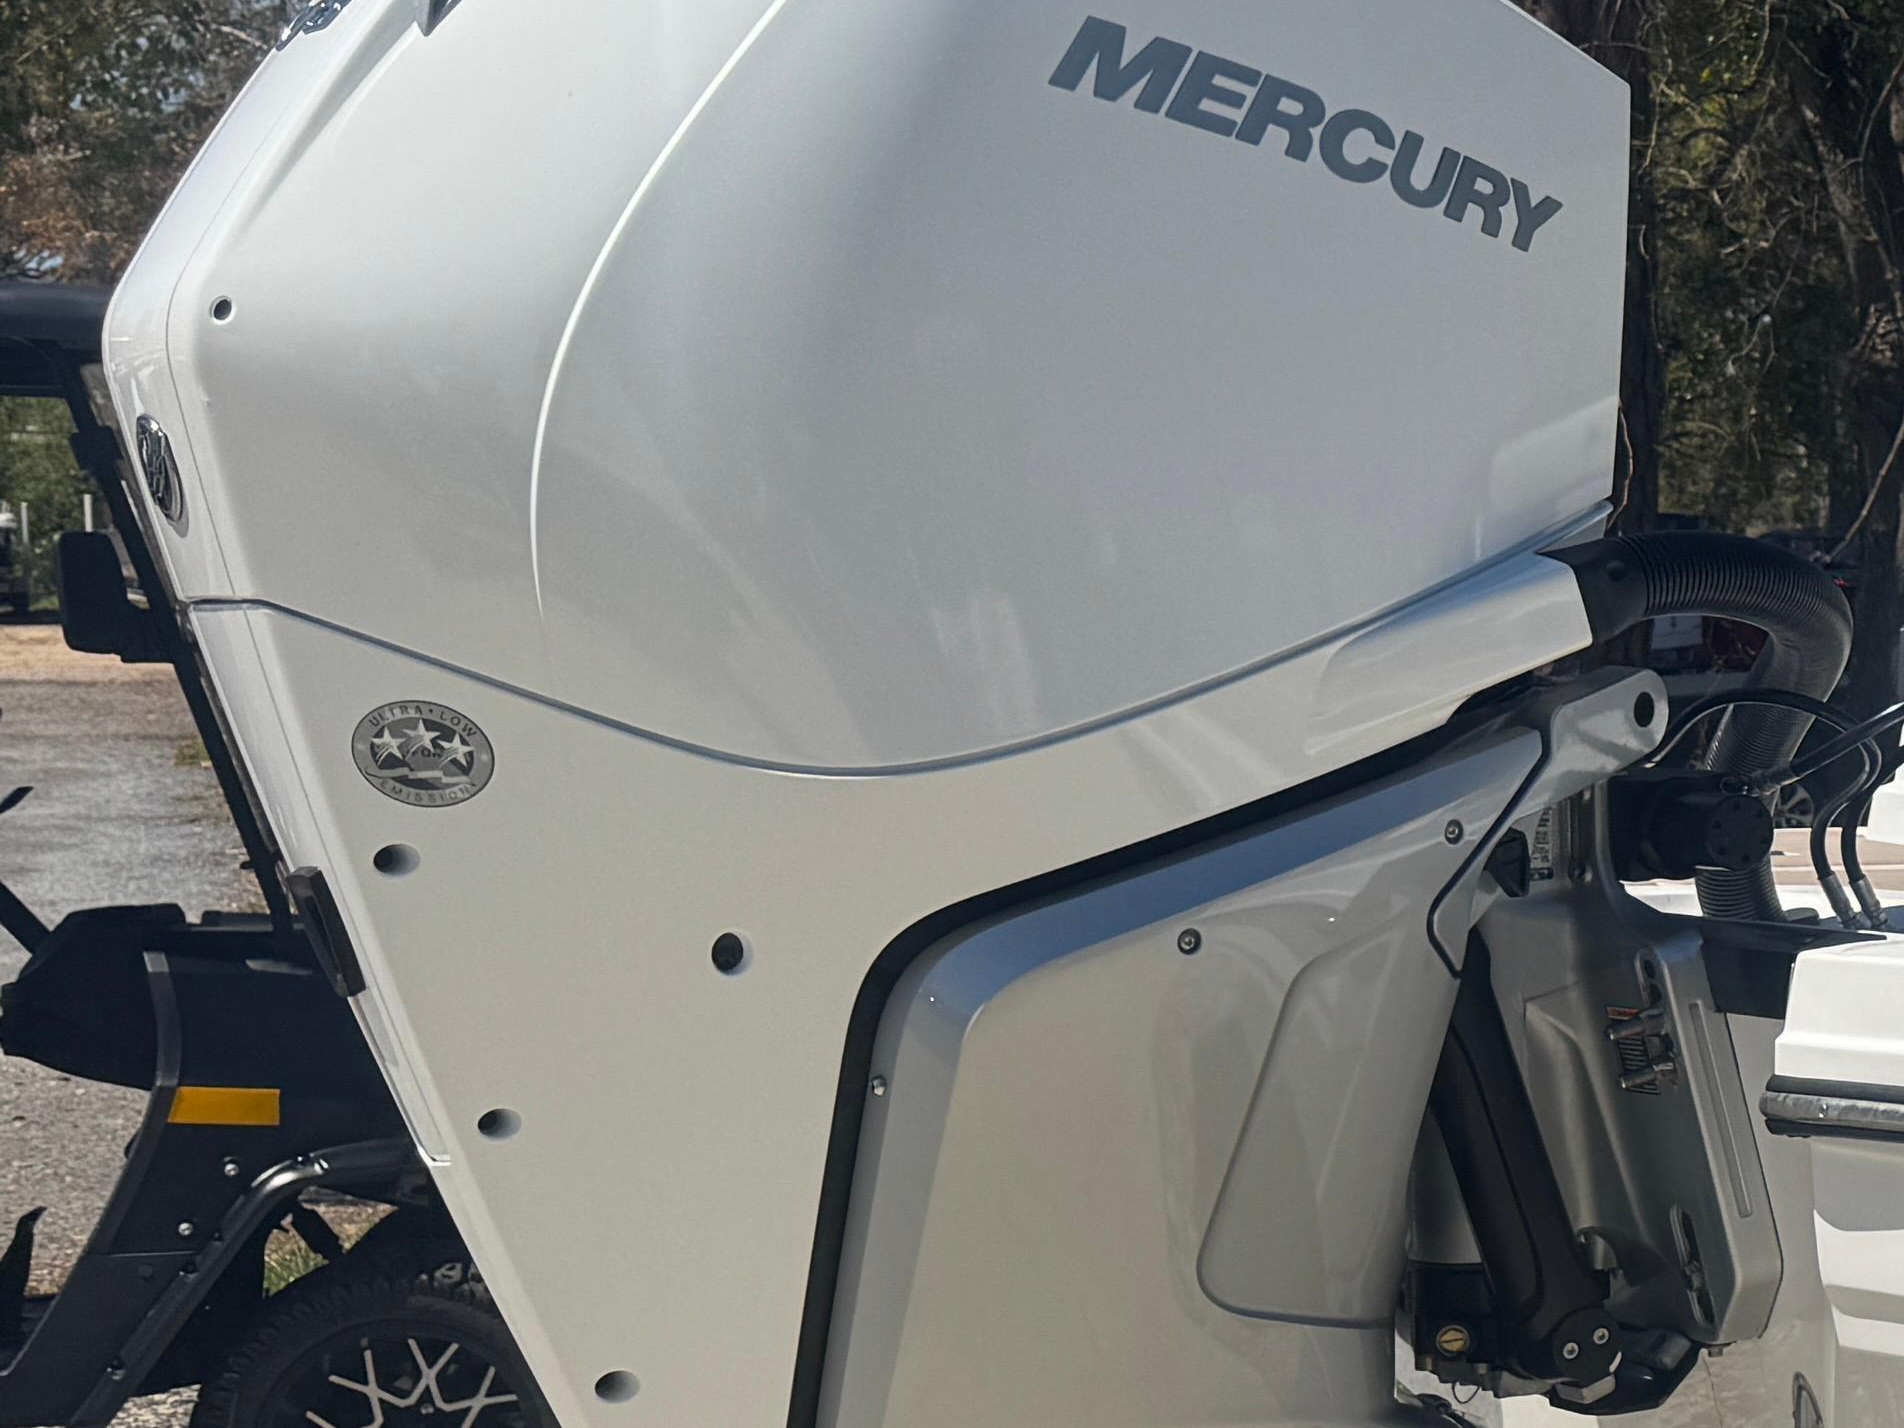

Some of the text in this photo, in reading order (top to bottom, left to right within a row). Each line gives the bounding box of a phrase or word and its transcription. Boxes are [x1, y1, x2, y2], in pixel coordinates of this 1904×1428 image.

[1048, 15, 1562, 253] MERCURY
[368, 705, 478, 737] ULTRA LOW
